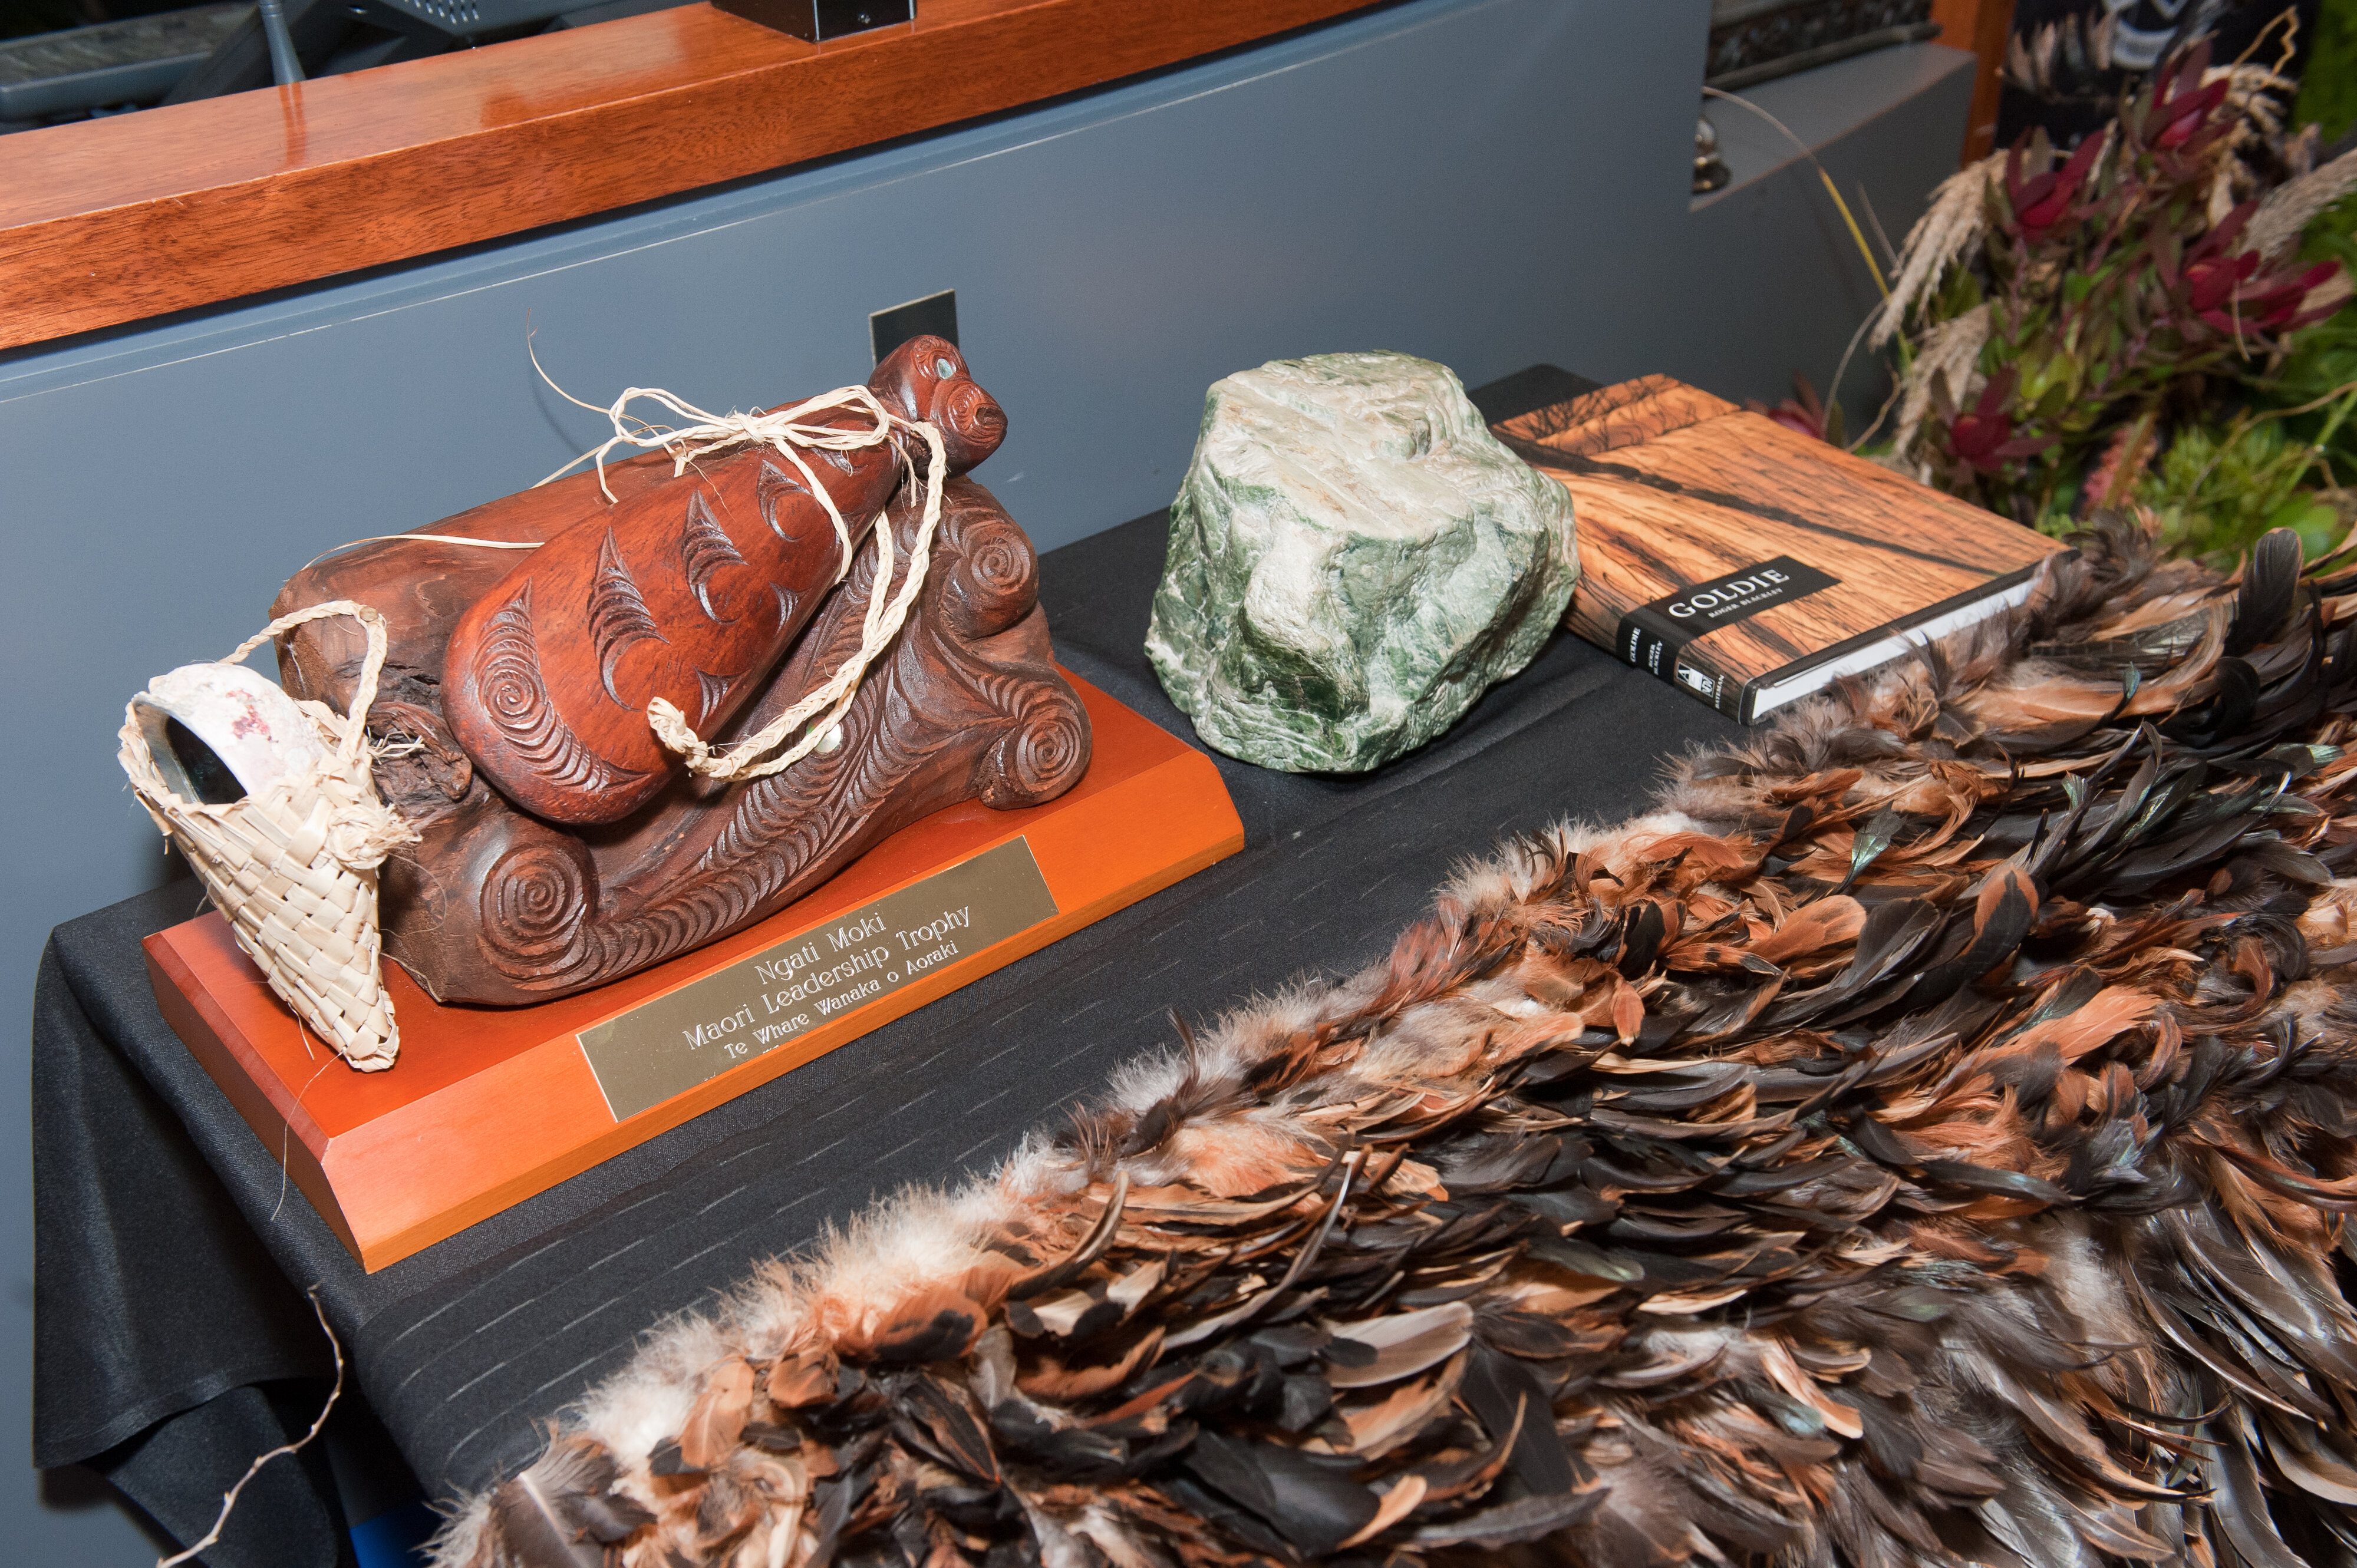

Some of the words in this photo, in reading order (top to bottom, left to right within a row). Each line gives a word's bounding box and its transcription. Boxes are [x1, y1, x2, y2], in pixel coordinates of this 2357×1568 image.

[1669, 569, 1790, 618] GOLDIE
[1630, 627, 1641, 663] GOLDIE
[1715, 674, 1725, 709] BATEMAN
[682, 1003, 756, 1050] Maori
[760, 946, 889, 1014] Leadership
[895, 906, 970, 950] Trophy
[754, 942, 820, 985] Ngati
[826, 912, 886, 952] Moki
[724, 1042, 748, 1059] Te
[752, 1013, 809, 1044] Whare
[813, 979, 882, 1015] Wanaka
[886, 971, 899, 983] o
[906, 940, 959, 975] Aoraki
